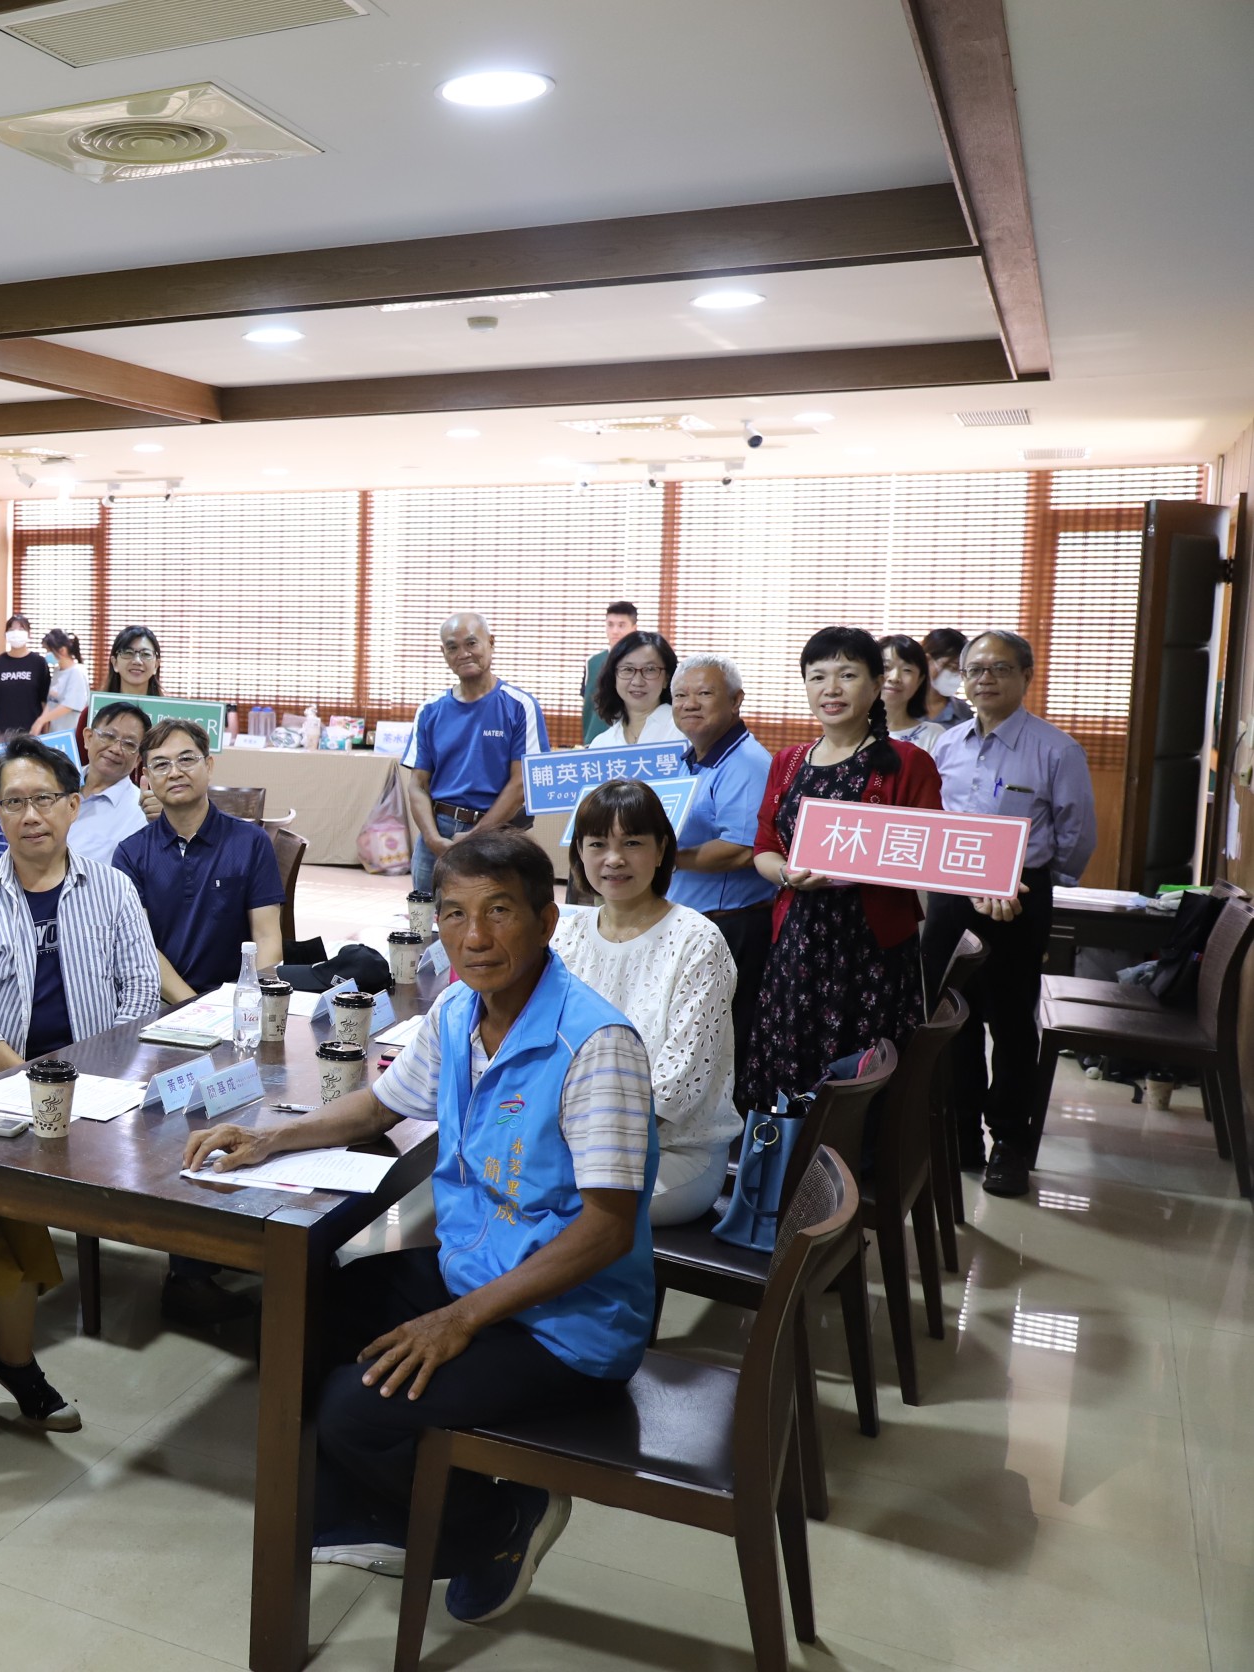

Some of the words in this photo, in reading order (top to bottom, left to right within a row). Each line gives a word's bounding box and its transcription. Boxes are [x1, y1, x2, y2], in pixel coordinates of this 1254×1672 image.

[0, 671, 32, 681] SPARSE
[531, 753, 679, 787] 輔英科技大學
[547, 790, 577, 802] Fooy
[820, 816, 993, 877] 林園區
[483, 1156, 517, 1226] 簡成
